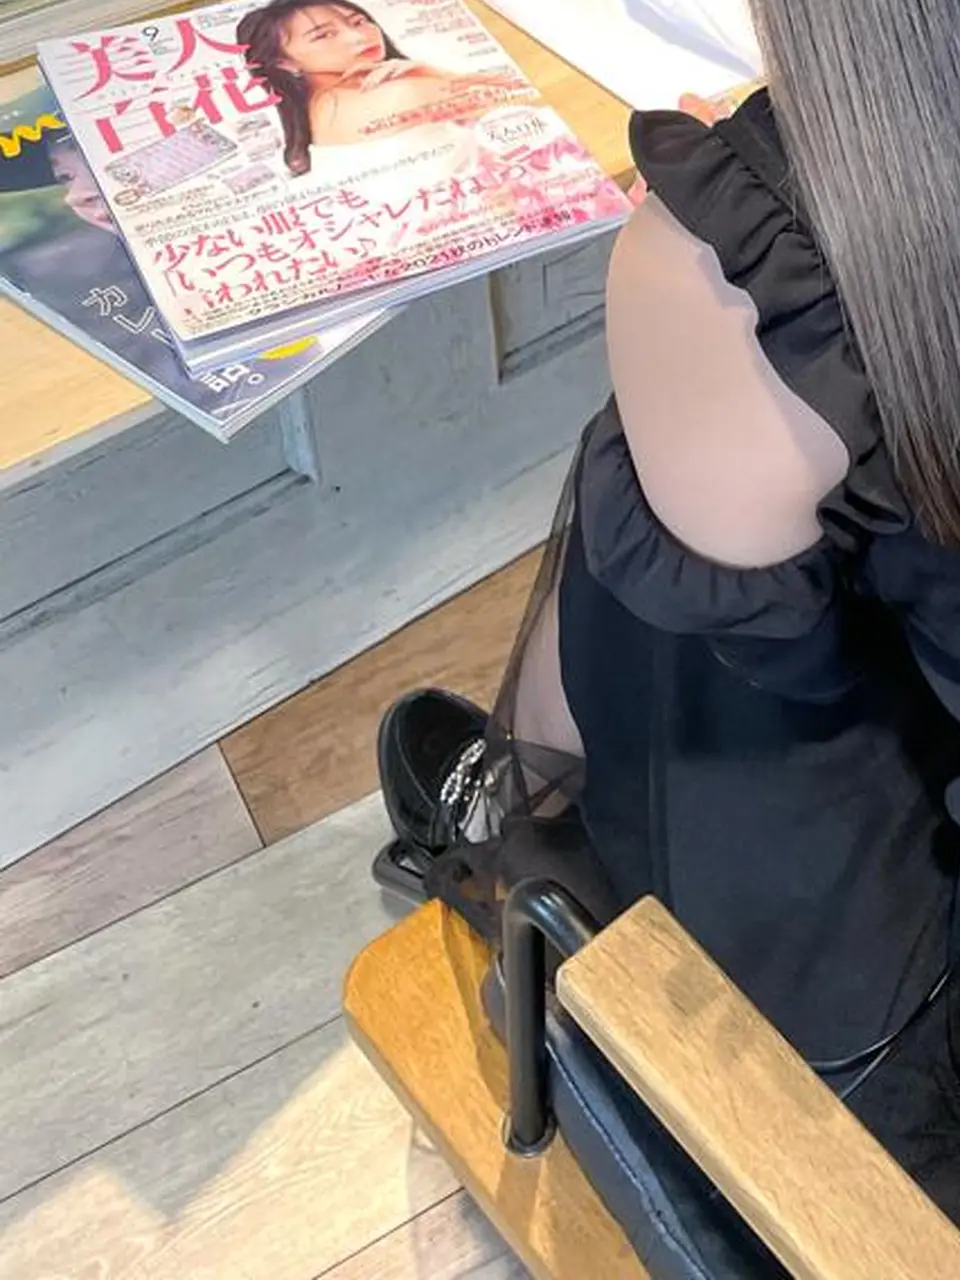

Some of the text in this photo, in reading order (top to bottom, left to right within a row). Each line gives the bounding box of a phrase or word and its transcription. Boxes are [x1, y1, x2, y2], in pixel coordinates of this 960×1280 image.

[70, 17, 251, 102] 美人
[142, 25, 159, 43] 9
[94, 62, 284, 154] 百花
[153, 188, 369, 271] 少ない服でも
